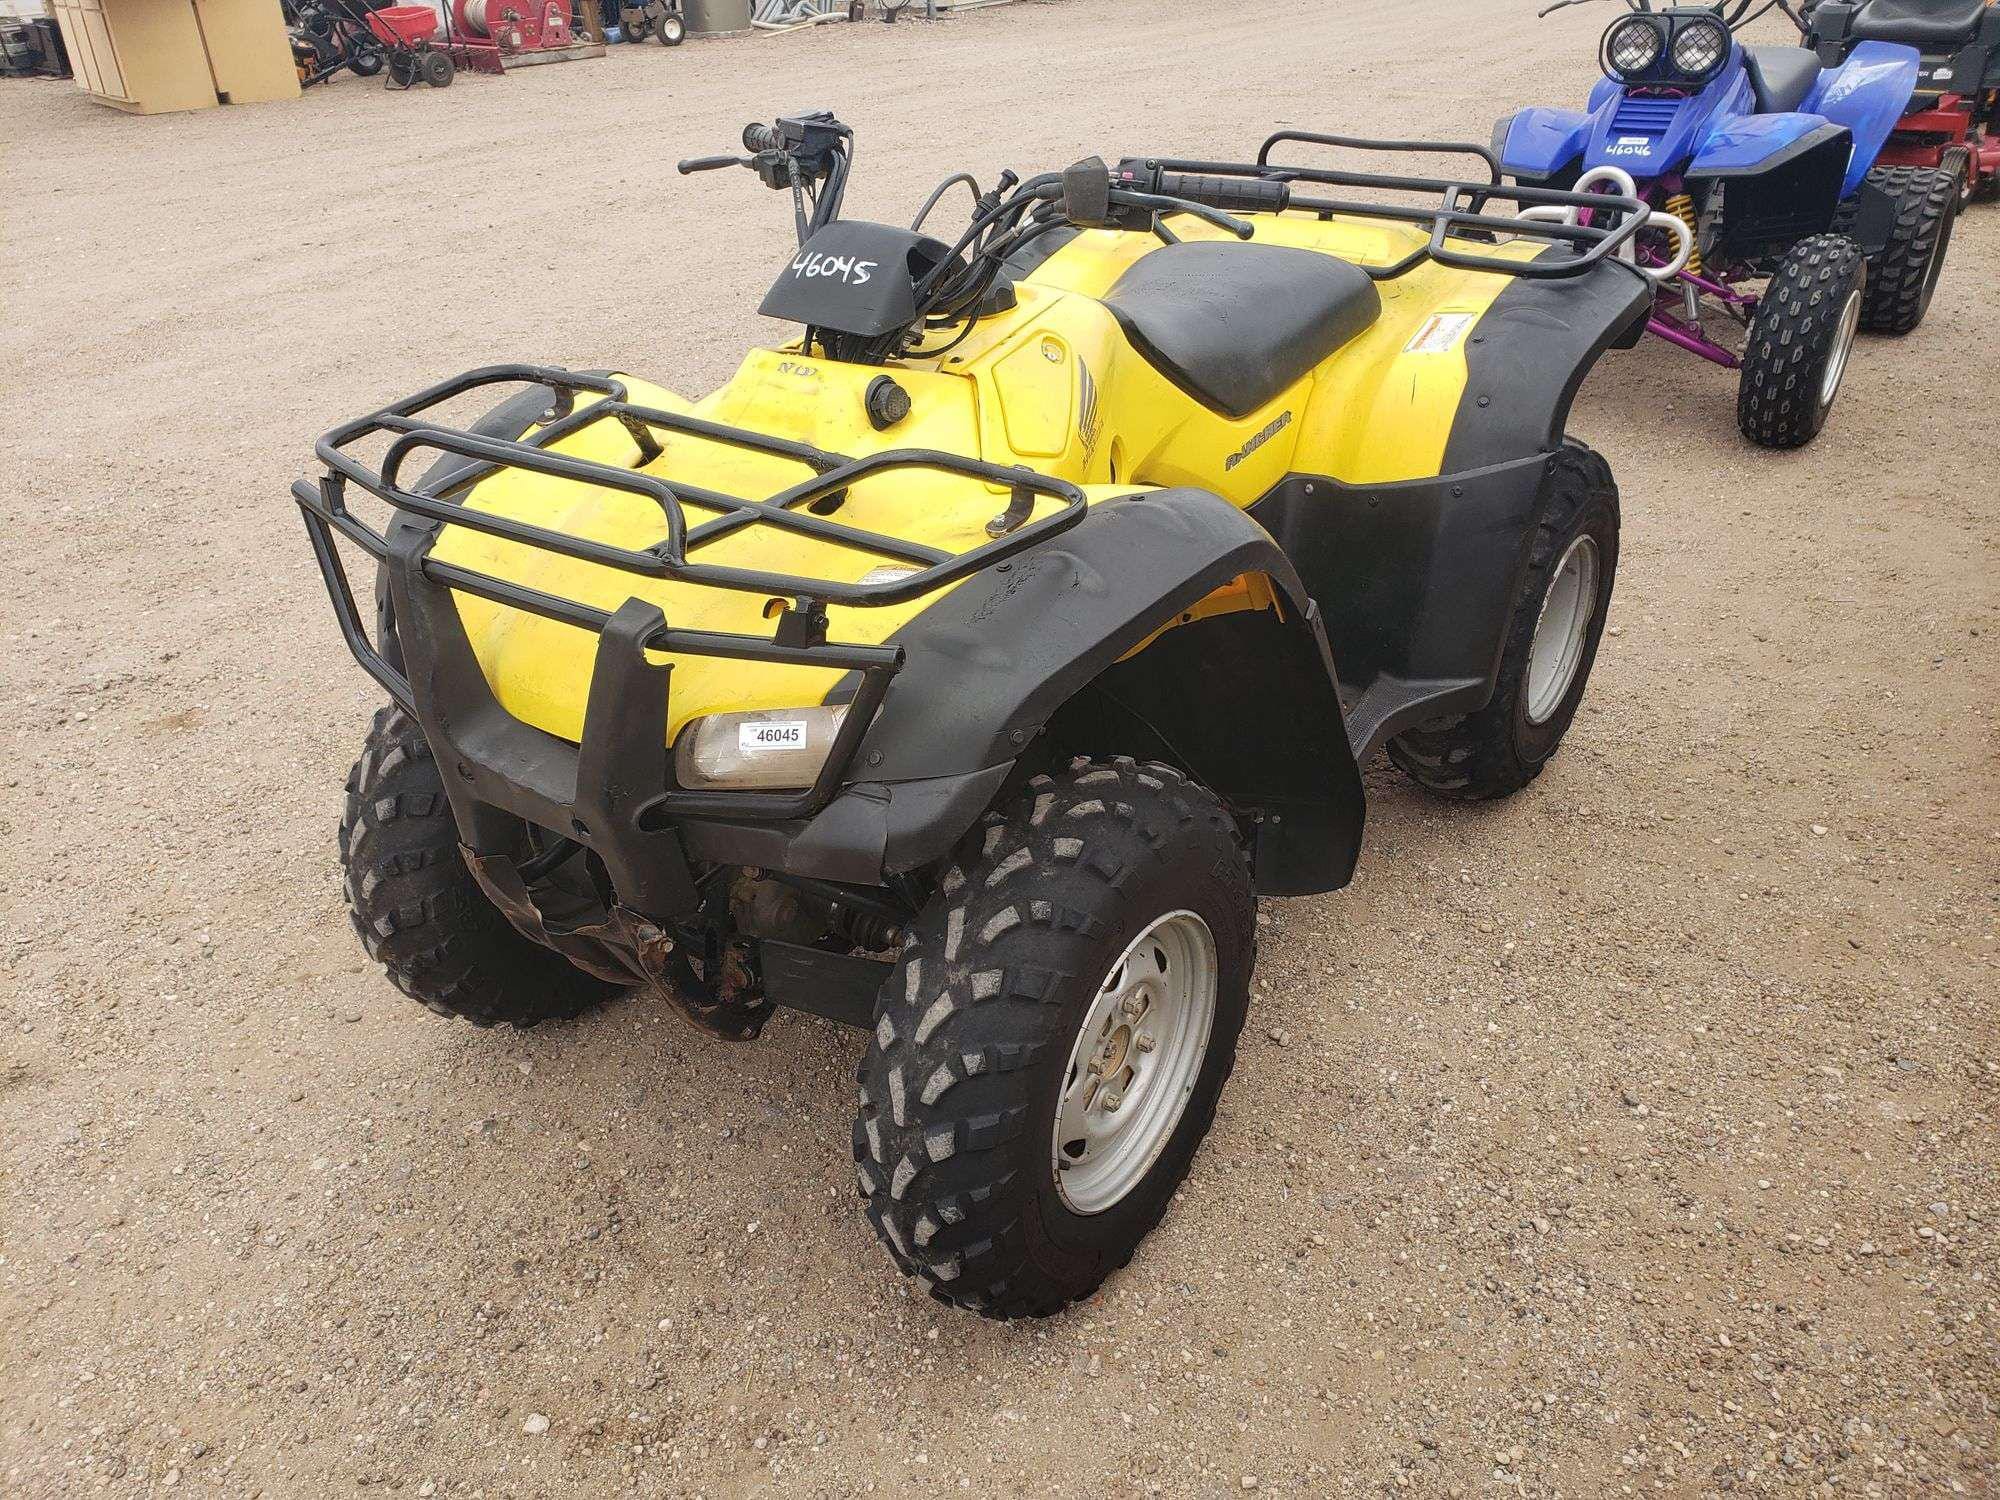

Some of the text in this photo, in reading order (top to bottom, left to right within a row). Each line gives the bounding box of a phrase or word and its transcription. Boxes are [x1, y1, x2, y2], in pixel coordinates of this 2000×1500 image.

[1605, 144, 1651, 156] 46046
[792, 251, 878, 285] 46045
[757, 728, 799, 742] 46045
